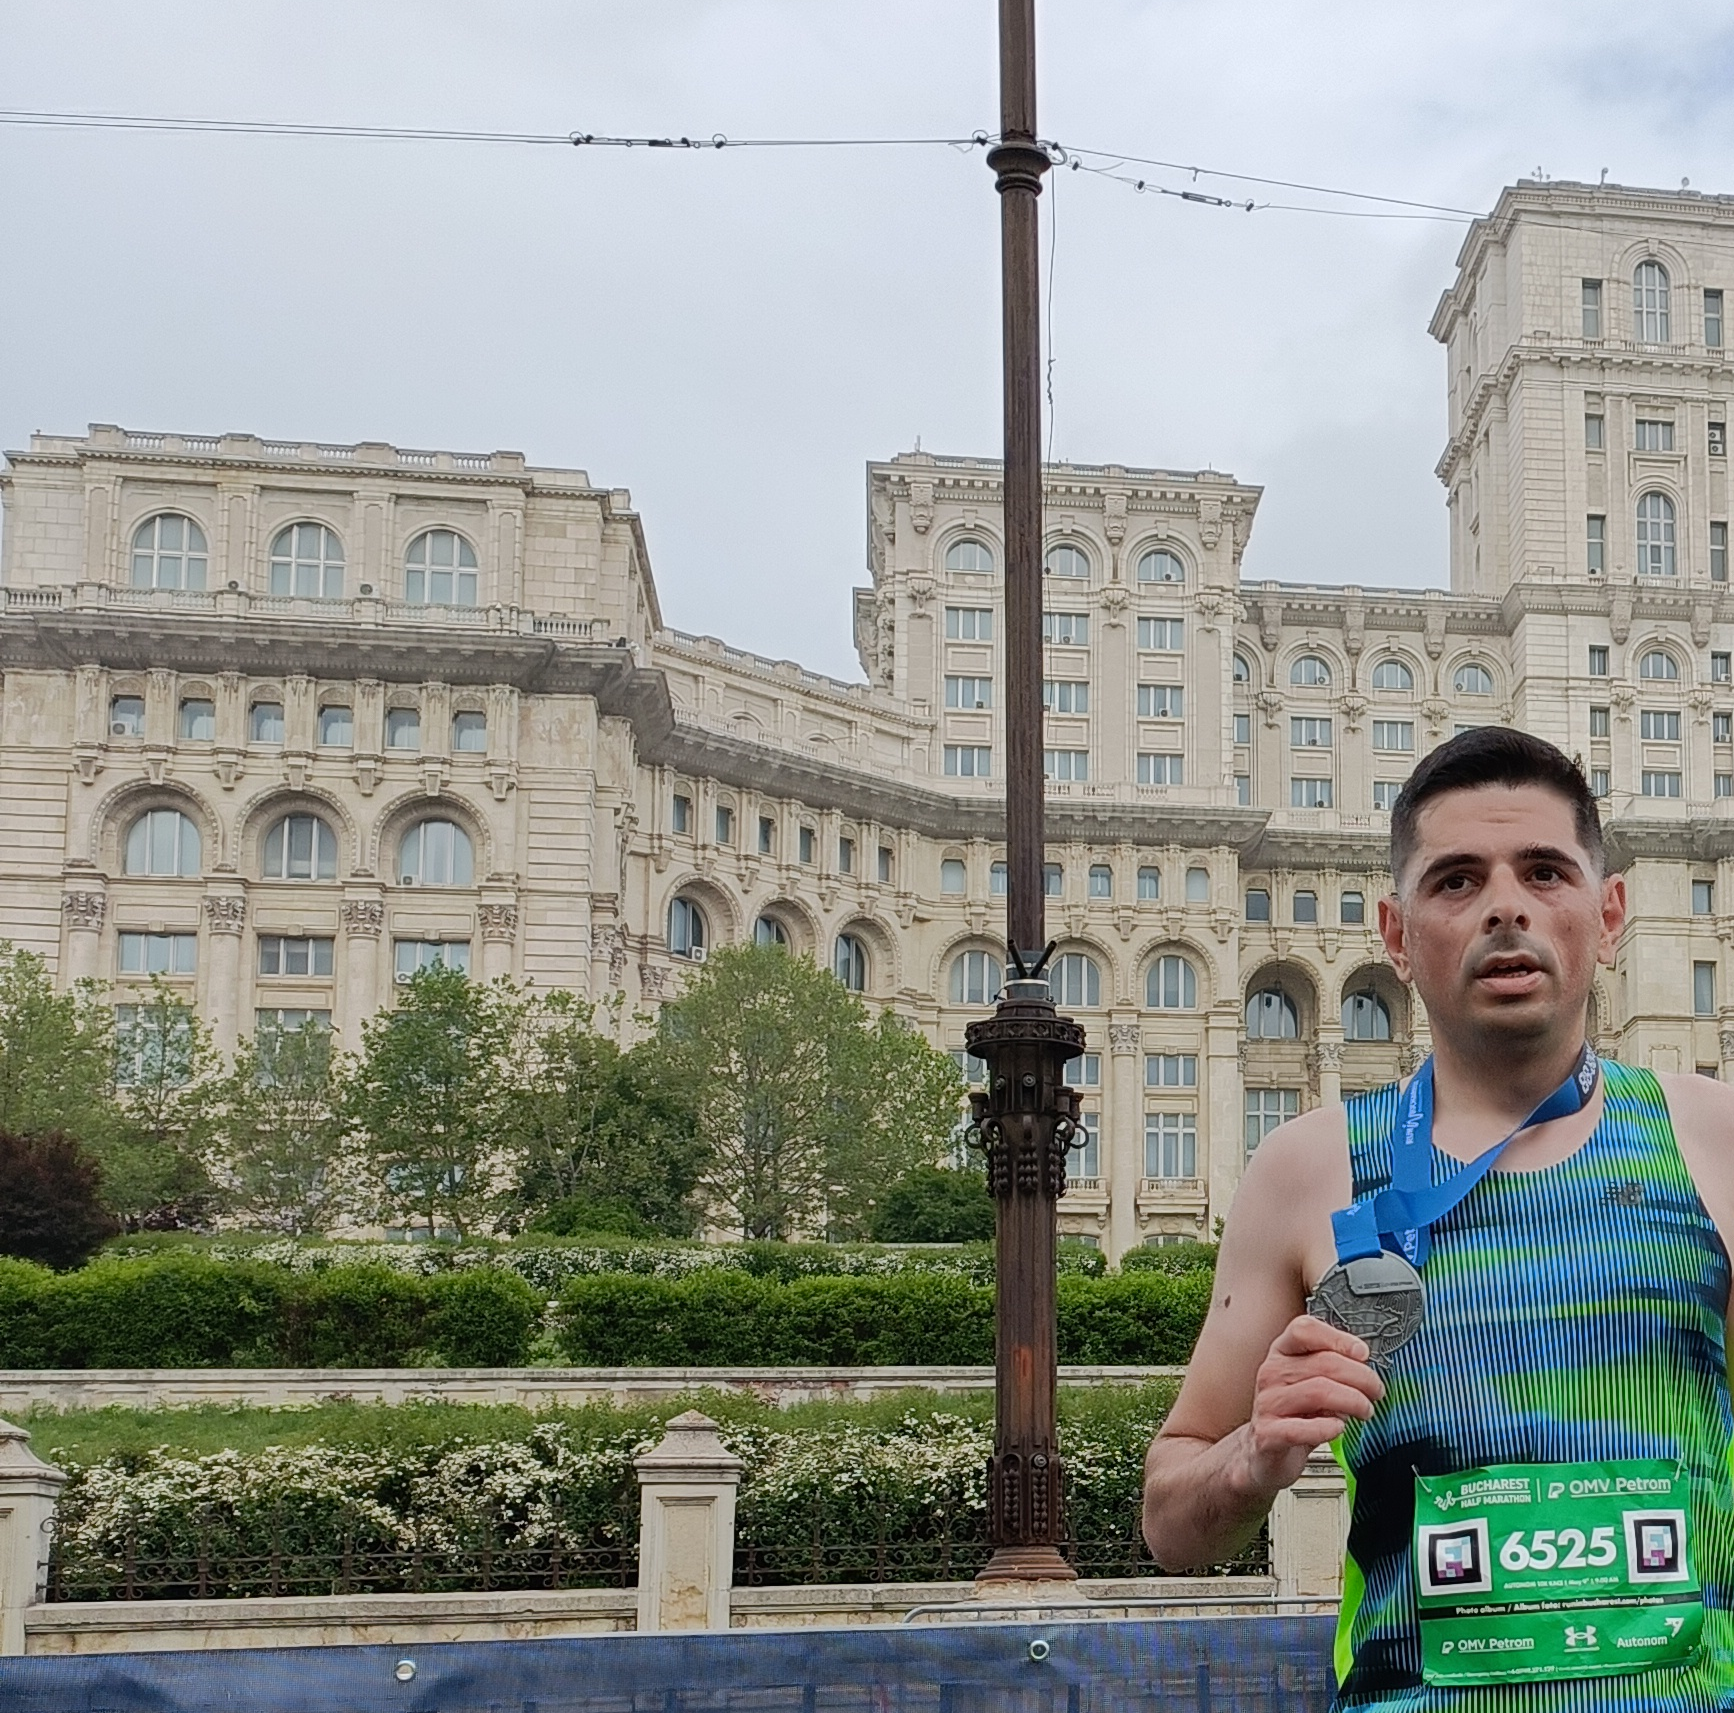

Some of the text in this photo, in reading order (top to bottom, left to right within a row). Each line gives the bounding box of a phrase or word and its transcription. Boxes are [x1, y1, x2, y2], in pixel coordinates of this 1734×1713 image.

[1460, 1478, 1531, 1496] BUCHAREST
[1569, 1477, 1671, 1494] OMV Petrom
[1460, 1494, 1532, 1508] HALF MARATHON
[1499, 1526, 1617, 1572] 6525
[1456, 1606, 1479, 1615] Photo
[1457, 1636, 1535, 1652] OMV Petrom
[1616, 1634, 1668, 1649] Autonom
